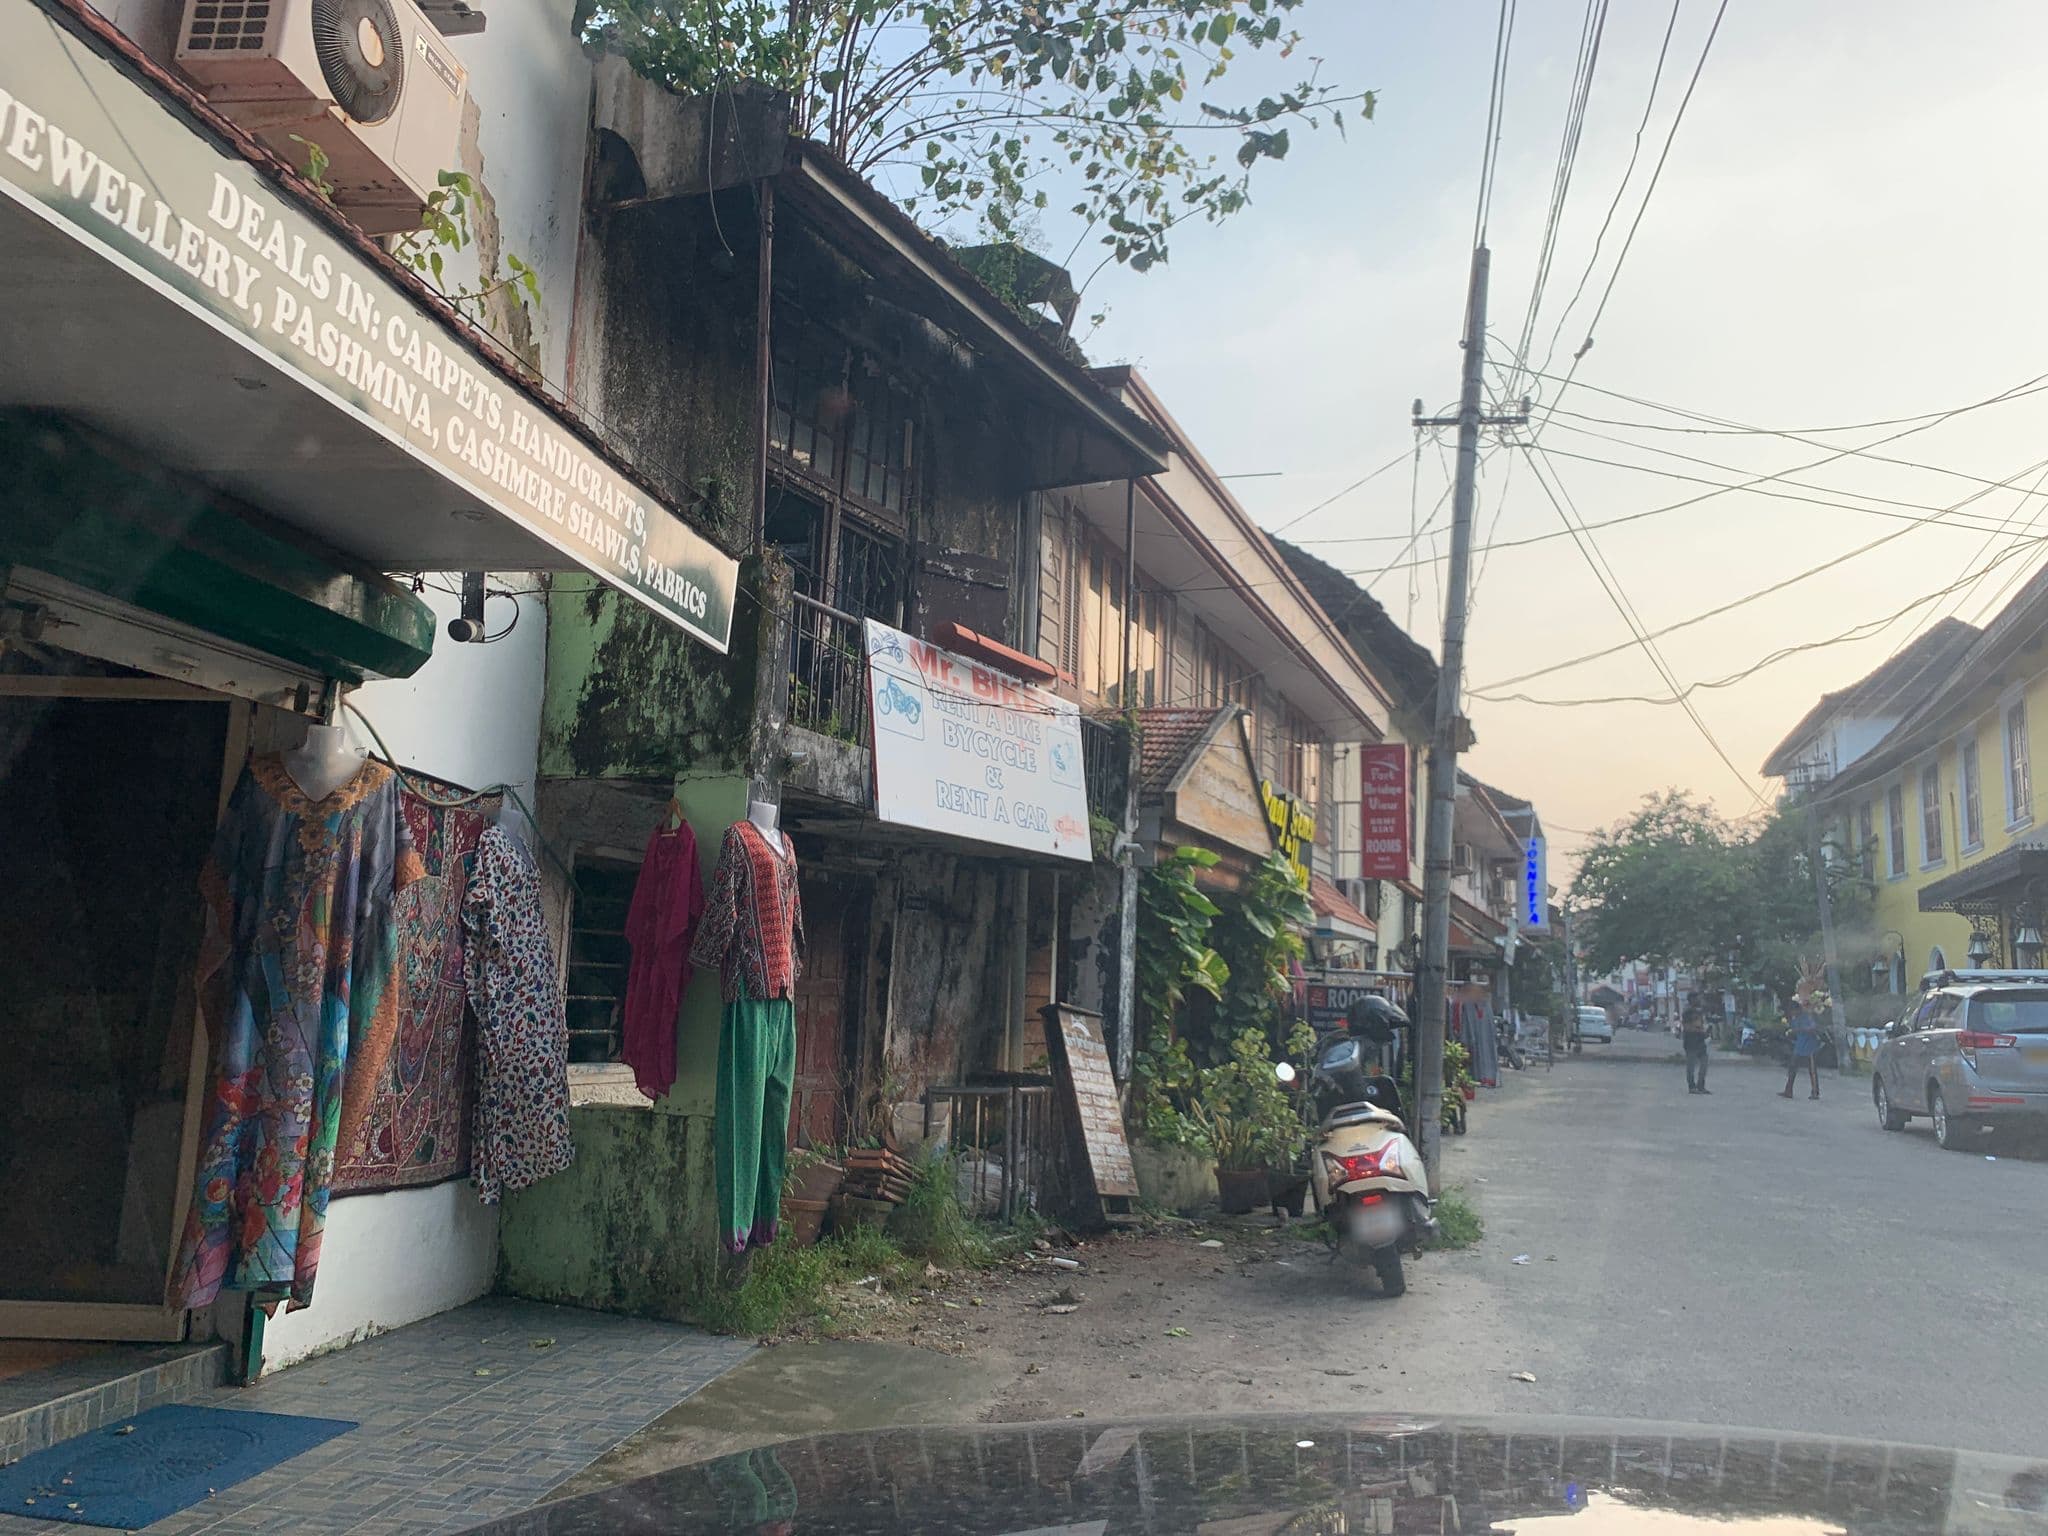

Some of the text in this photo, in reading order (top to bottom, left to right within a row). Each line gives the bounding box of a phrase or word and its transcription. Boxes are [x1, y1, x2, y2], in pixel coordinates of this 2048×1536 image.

[207, 171, 648, 548] DEALS IN: CARPETS, HANDICRAFTS,
[270, 286, 440, 449] PASHMINA,
[446, 415, 567, 527] CASHMERE
[567, 499, 643, 586] SHAWLS,
[643, 554, 708, 620] FABRICS
[908, 638, 961, 686] Mr.
[931, 681, 1042, 746] RENT A BIKE
[942, 718, 1038, 773] BYCYCLE
[985, 764, 1004, 790] &
[935, 778, 989, 819] RENT
[994, 796, 1010, 824] A
[1013, 801, 1050, 833] CAR
[1366, 838, 1402, 853] ROOMS
